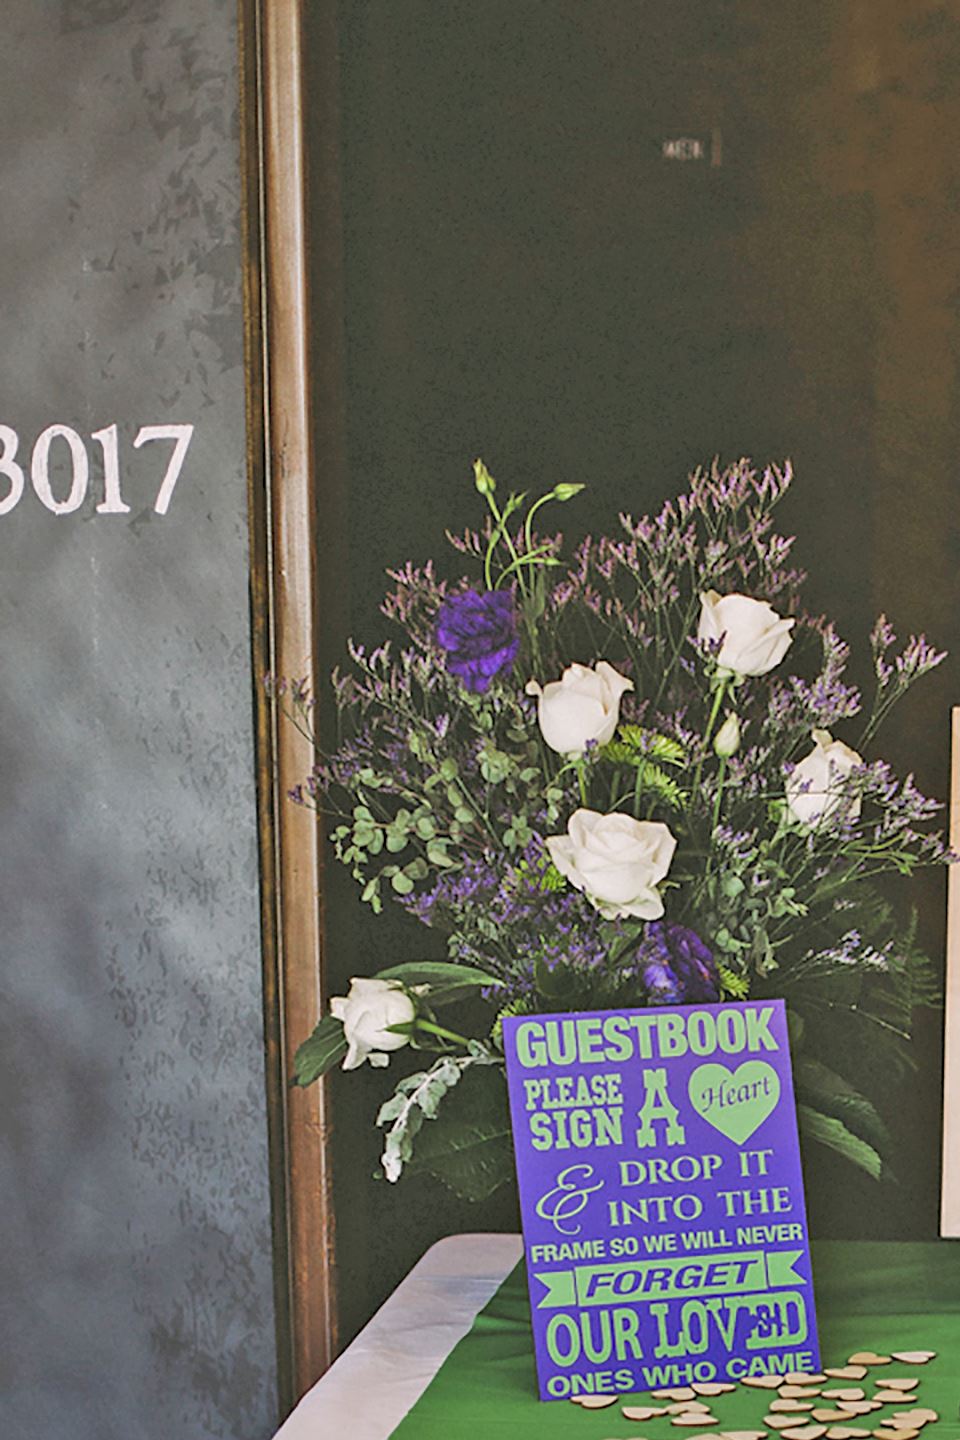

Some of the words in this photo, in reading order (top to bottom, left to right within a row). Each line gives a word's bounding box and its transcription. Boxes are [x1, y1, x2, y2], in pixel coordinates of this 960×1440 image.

[515, 1007, 779, 1068] GUESTBOOK
[524, 1073, 623, 1111] PLEASE
[529, 1106, 623, 1151] SIGN
[636, 1068, 685, 1148] A
[701, 1075, 772, 1113] Heart
[535, 1164, 604, 1236] &
[619, 1153, 723, 1188] DROP
[739, 1149, 774, 1178] IT
[607, 1194, 703, 1227] INTO
[717, 1187, 793, 1218] THE
[531, 1239, 605, 1264] FRAME
[609, 1237, 639, 1257] SO
[643, 1234, 678, 1254] WE
[681, 1229, 733, 1251] WILL
[737, 1223, 803, 1246] NEVER
[585, 1259, 759, 1298] FORGET
[546, 1307, 643, 1367] OUR
[547, 1369, 635, 1397] ONES
[642, 1361, 717, 1387] WHO
[726, 1351, 814, 1379] CAME
